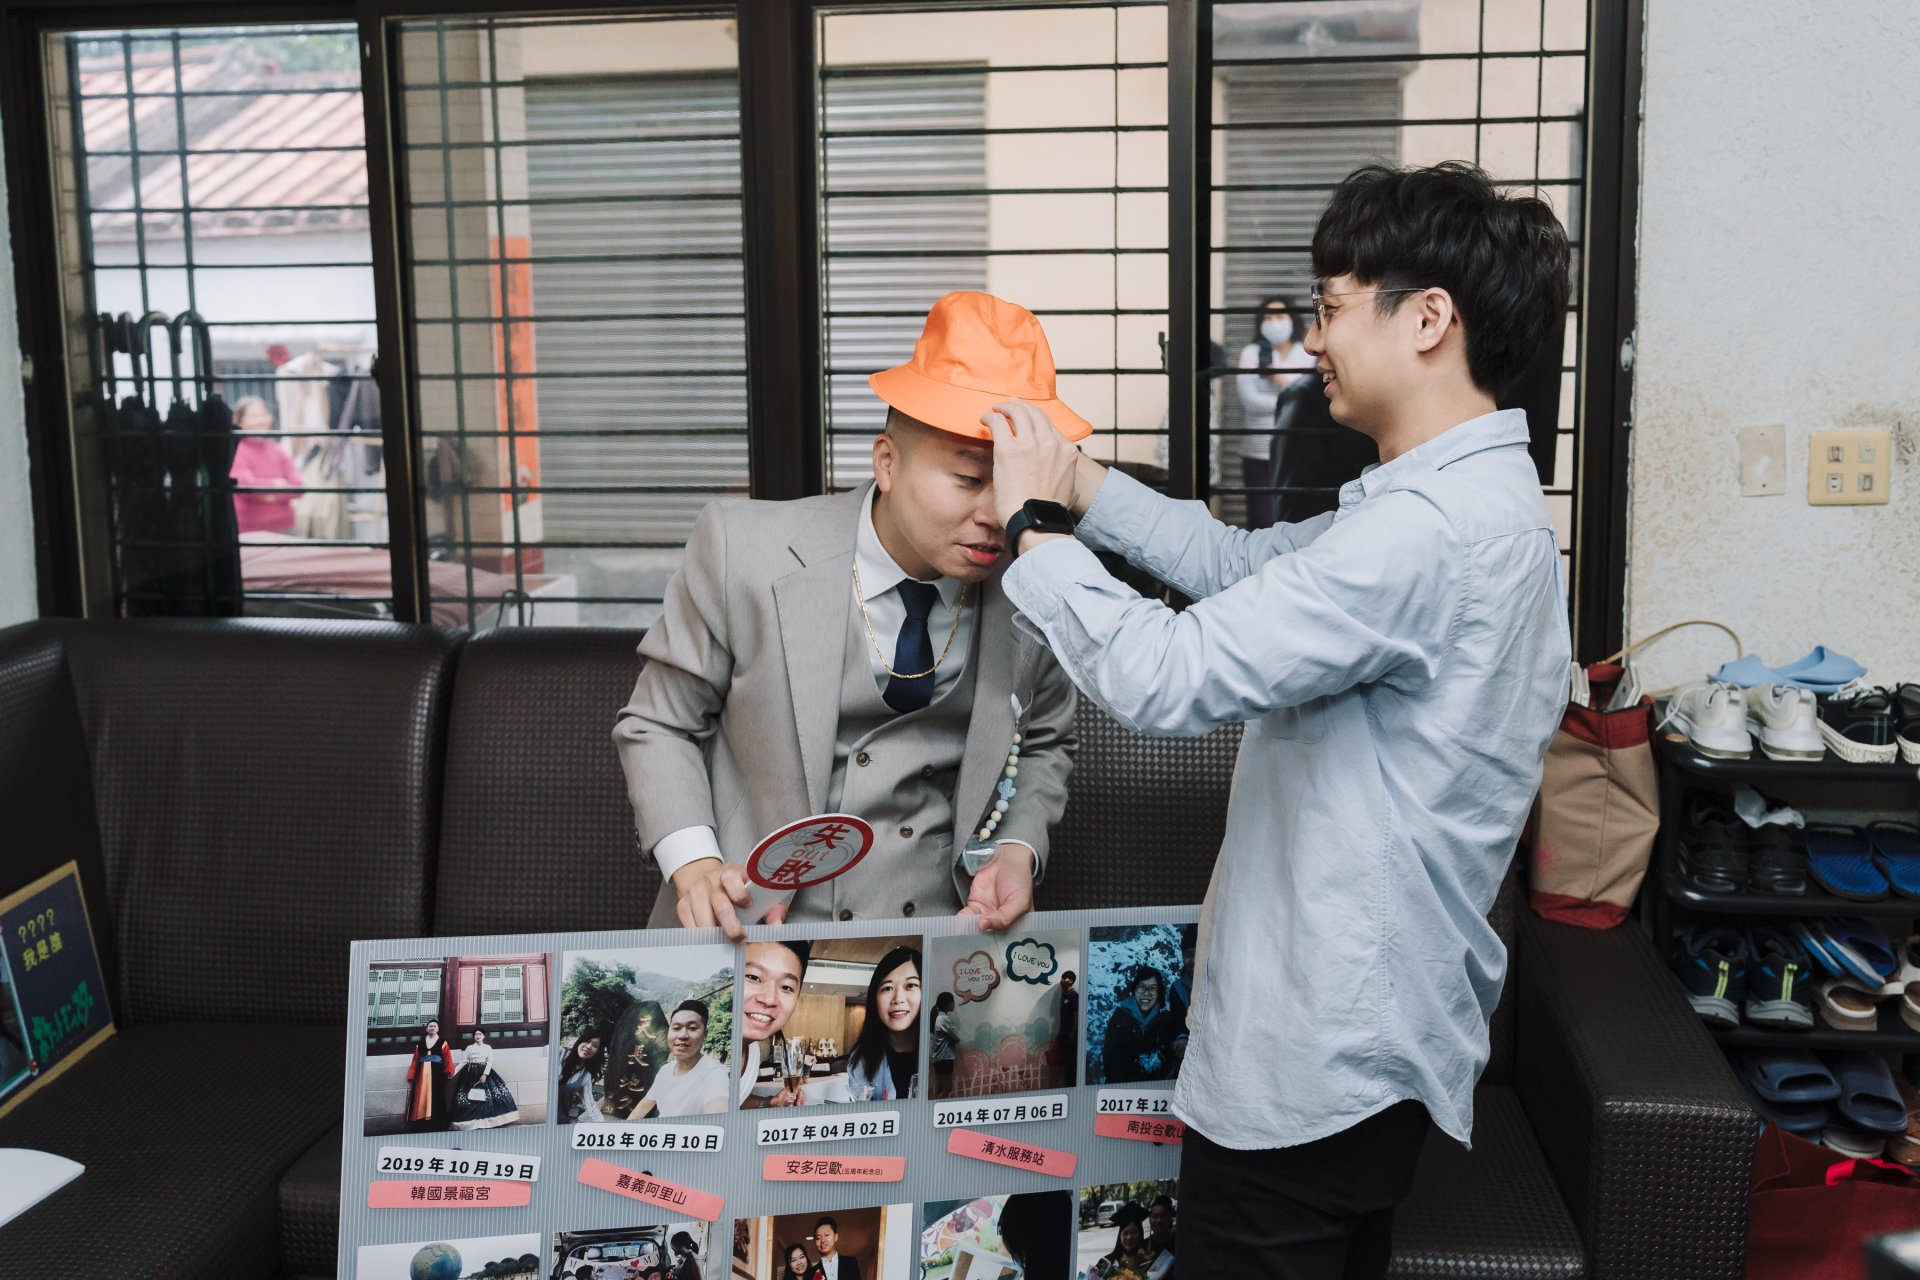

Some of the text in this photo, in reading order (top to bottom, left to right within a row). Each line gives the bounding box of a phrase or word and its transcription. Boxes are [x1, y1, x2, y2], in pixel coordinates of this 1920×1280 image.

[18, 908, 55, 944] ????
[1018, 953, 1037, 965] LOVE
[964, 968, 981, 976] LOVE
[981, 974, 994, 982] TOO
[938, 1103, 1063, 1125] 2014 年 07 月 06 日
[1100, 1098, 1168, 1112] 2017 年 12
[576, 1132, 718, 1150] 2018 年 06 月 10 日
[761, 1120, 894, 1142] 2017 年 04 月 02 日
[981, 1140, 1046, 1166] 清水服務站
[381, 1157, 534, 1180] 2019 年 10 月 19 日
[410, 1186, 491, 1201] 韓國景福宮
[615, 1173, 688, 1205] 嘉義阿里山
